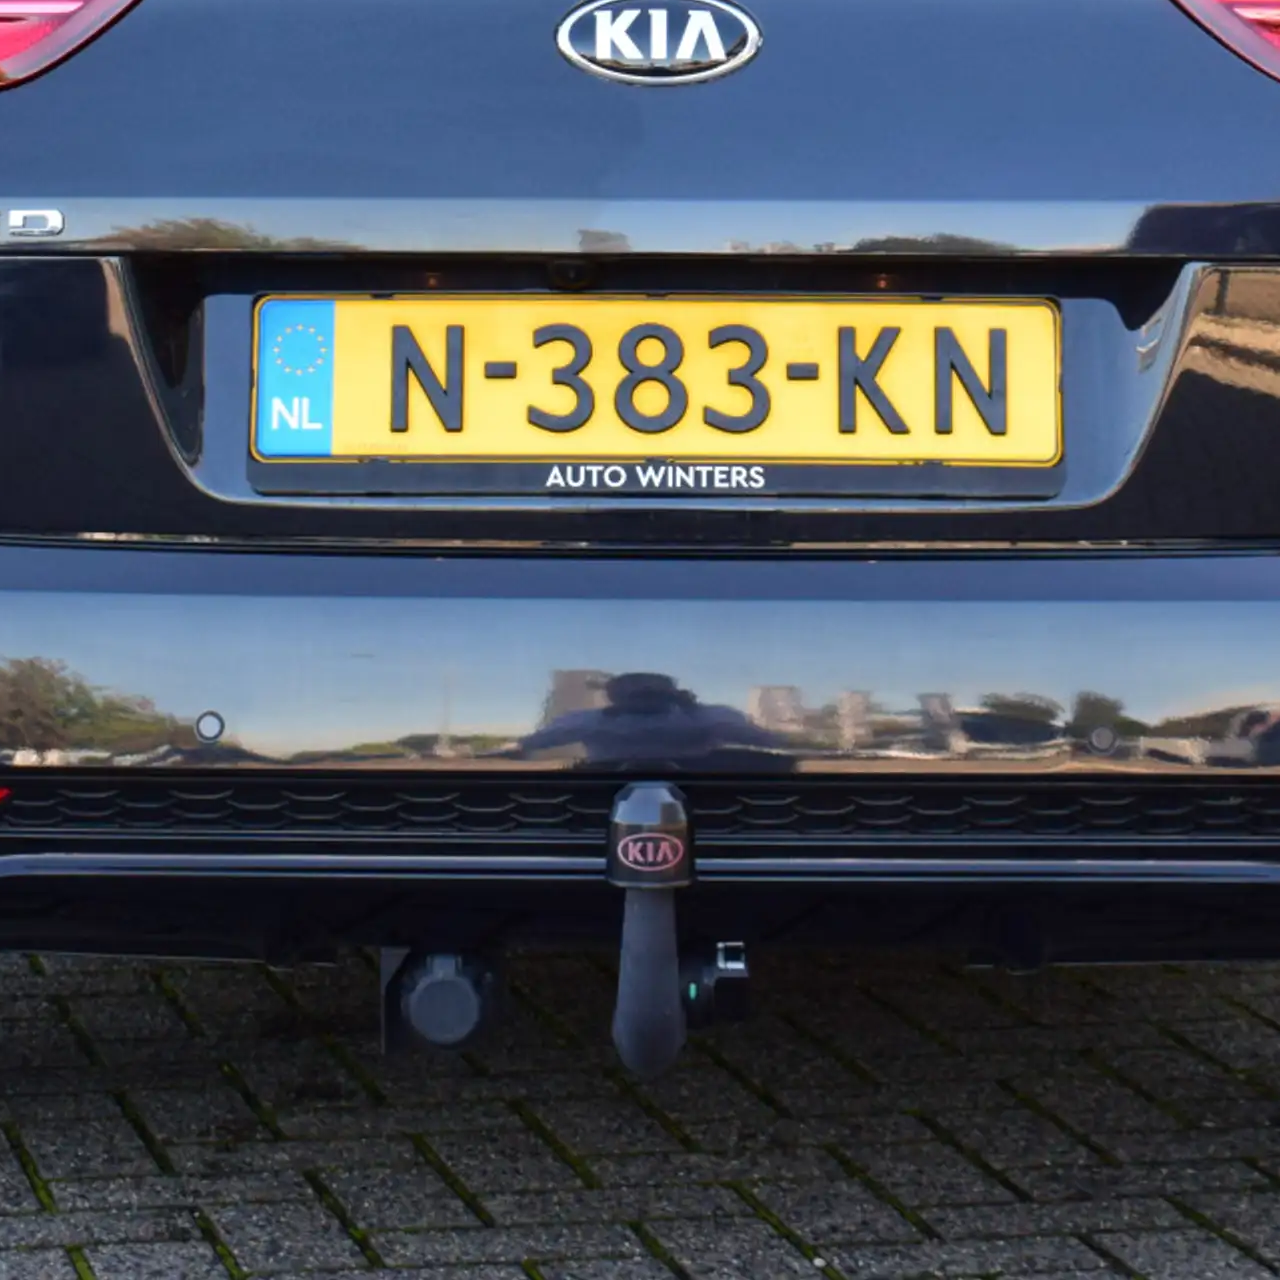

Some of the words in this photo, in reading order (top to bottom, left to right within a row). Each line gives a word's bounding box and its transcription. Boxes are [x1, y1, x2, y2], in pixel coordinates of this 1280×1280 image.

[593, 8, 727, 60] KIA
[389, 323, 1007, 435] N-383-KN
[271, 396, 323, 430] NL
[545, 465, 627, 488] AUTO
[635, 465, 766, 488] WINTERS
[627, 841, 676, 863] KIA
